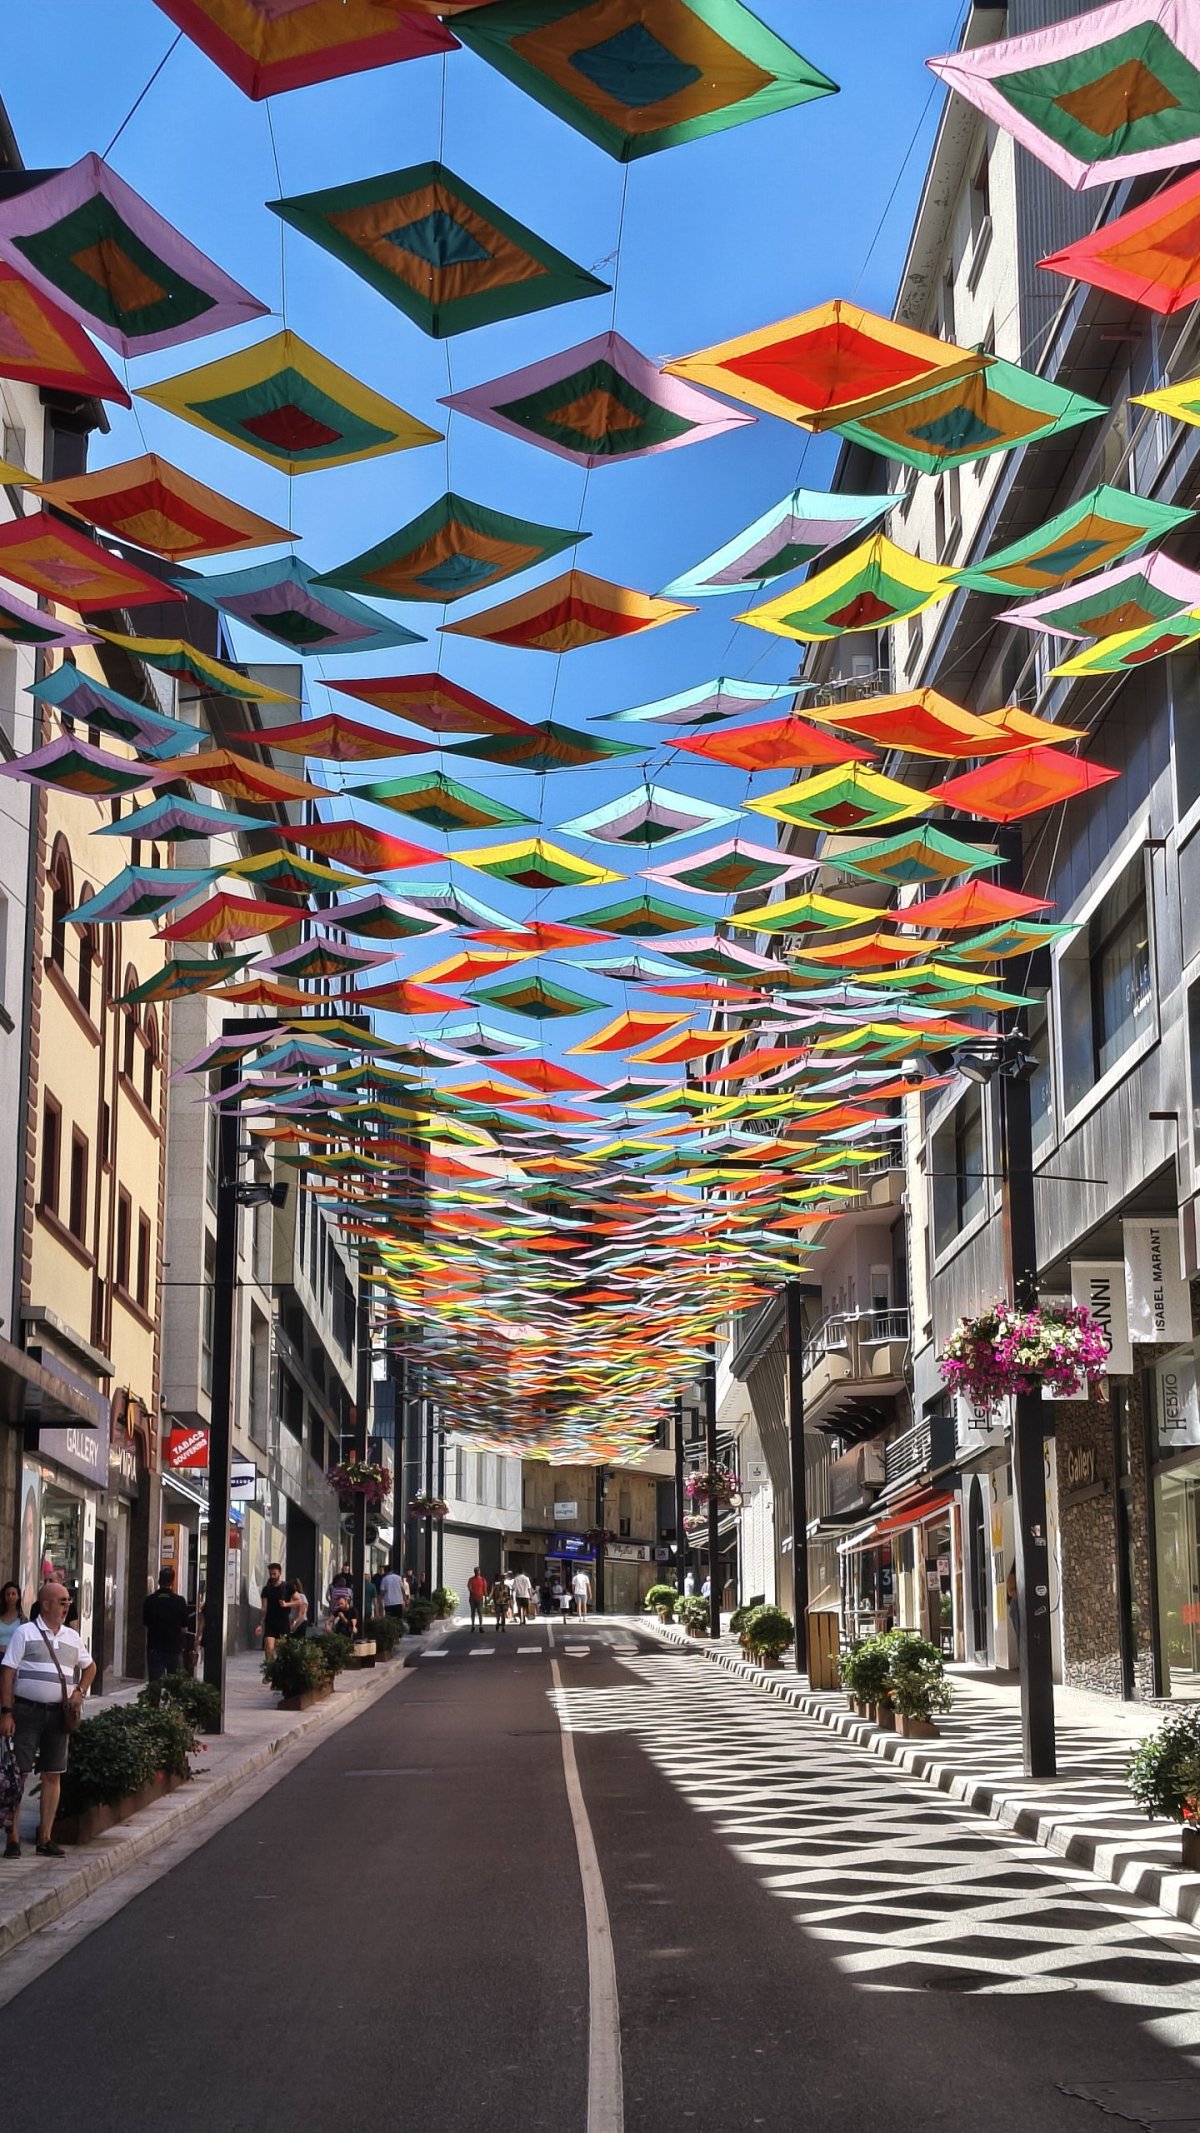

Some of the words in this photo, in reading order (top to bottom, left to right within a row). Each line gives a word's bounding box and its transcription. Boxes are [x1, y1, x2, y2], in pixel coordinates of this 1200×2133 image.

[1150, 1228, 1162, 1282] MARANT
[1153, 1286, 1165, 1332] ISABEL
[66, 1428, 99, 1467] GALLERY
[172, 1430, 205, 1455] TABACS
